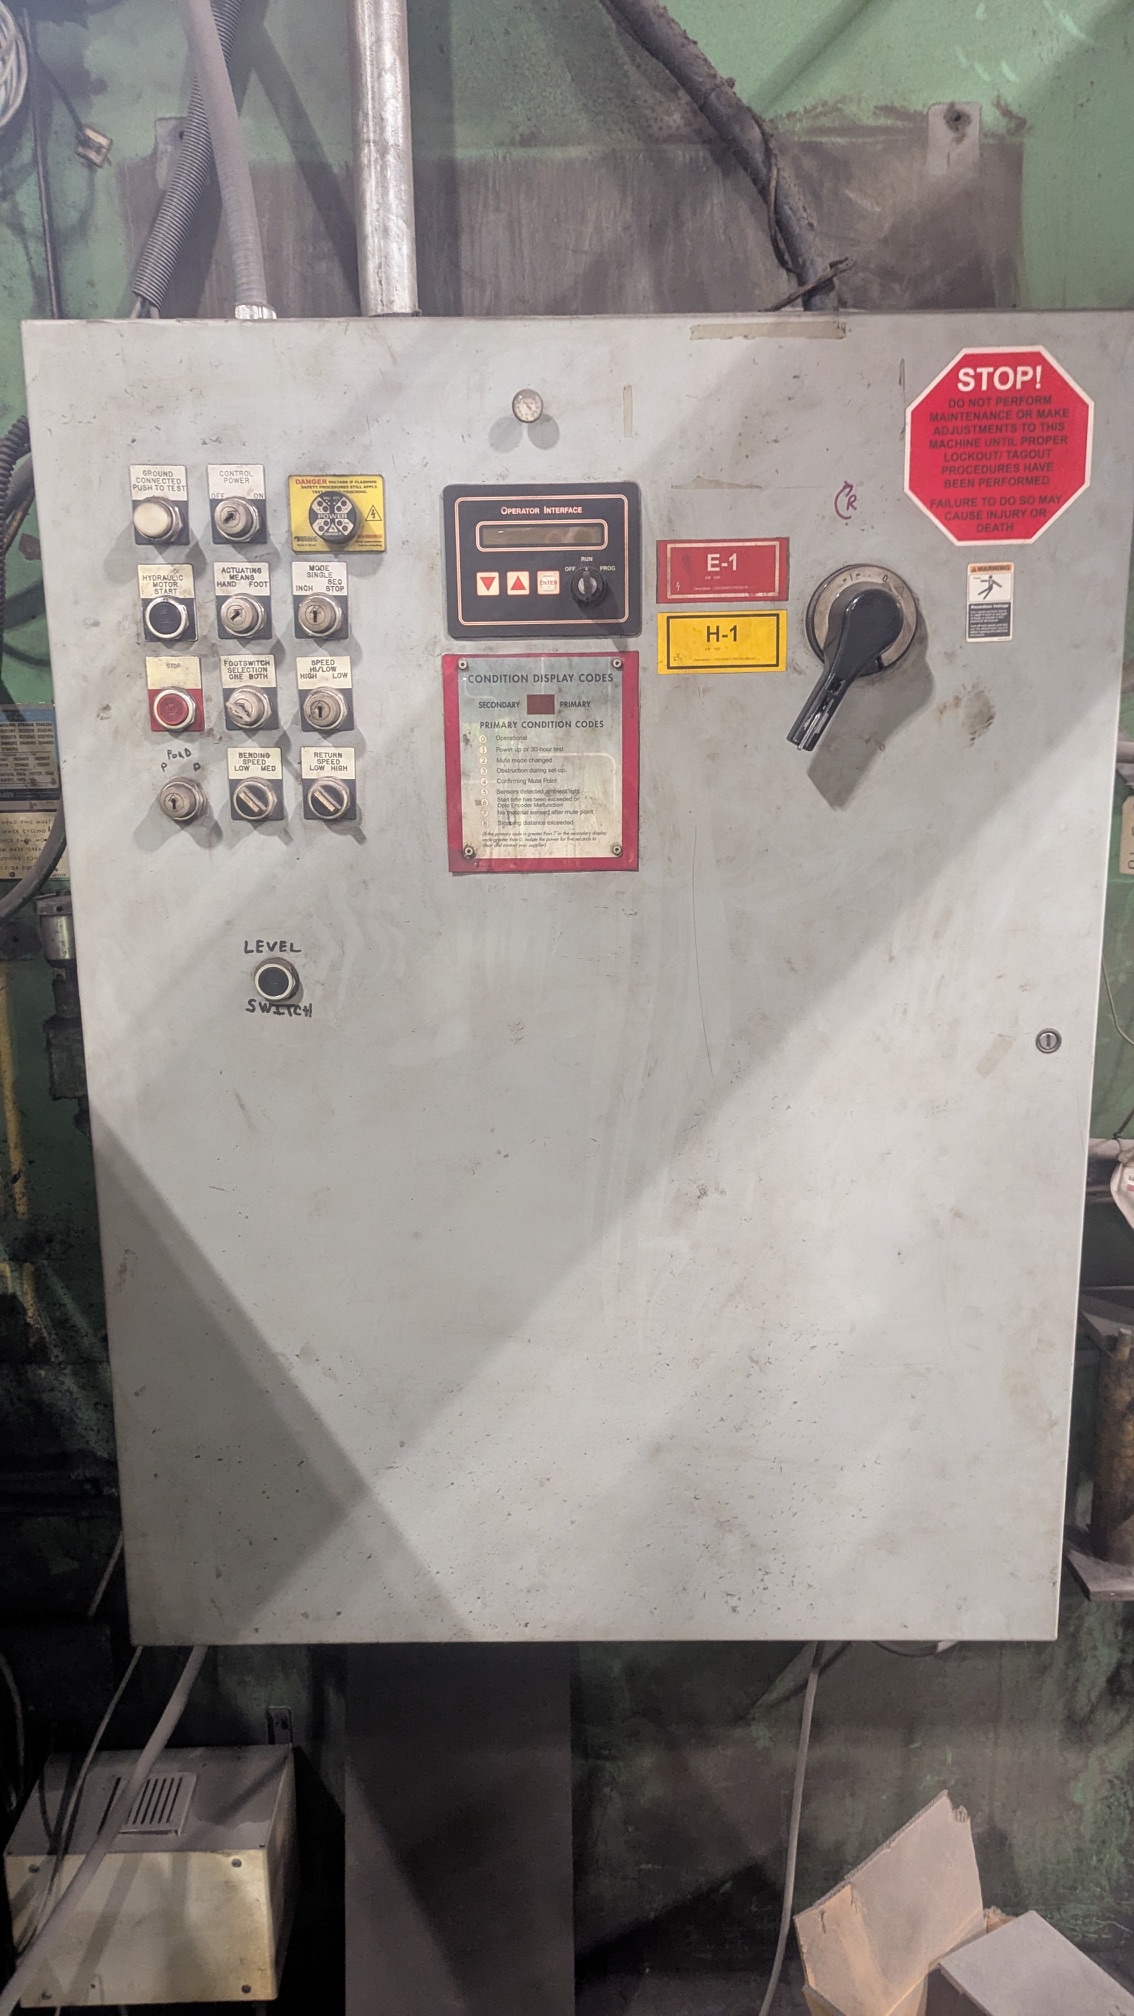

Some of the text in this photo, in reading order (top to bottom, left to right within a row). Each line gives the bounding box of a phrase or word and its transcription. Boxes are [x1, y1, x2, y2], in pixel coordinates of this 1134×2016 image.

[957, 365, 1042, 392] STOP!
[948, 395, 1052, 409] DO NOT PERFORM
[930, 408, 1069, 422] MAINTENANCE OR MAKE
[933, 422, 1065, 436] ADJUSTMENTS TO THIS
[929, 436, 1068, 449] MACHINE UNTIL PROPER
[1006, 449, 1052, 460] TAGOUT
[941, 462, 1054, 475] PROCEDURES HAVE
[136, 477, 182, 485] CONNECTED
[944, 476, 1050, 488] BEEN PERFORMED
[846, 494, 857, 511] R
[930, 494, 1063, 508] FAILURE TO DO SO MAY
[944, 508, 1047, 521] CAUSE INJURY OR
[976, 522, 1013, 533] DEATH
[707, 553, 737, 572] E-1
[977, 564, 1011, 572] WARNING
[706, 625, 737, 642] H-1
[468, 674, 614, 683] CONDITION DISPLAY CODES
[478, 701, 520, 709] SECONDARY
[575, 720, 604, 728] CODES
[161, 762, 168, 772] P
[244, 940, 302, 954] LEVEL
[246, 998, 313, 1018] SWITCH
